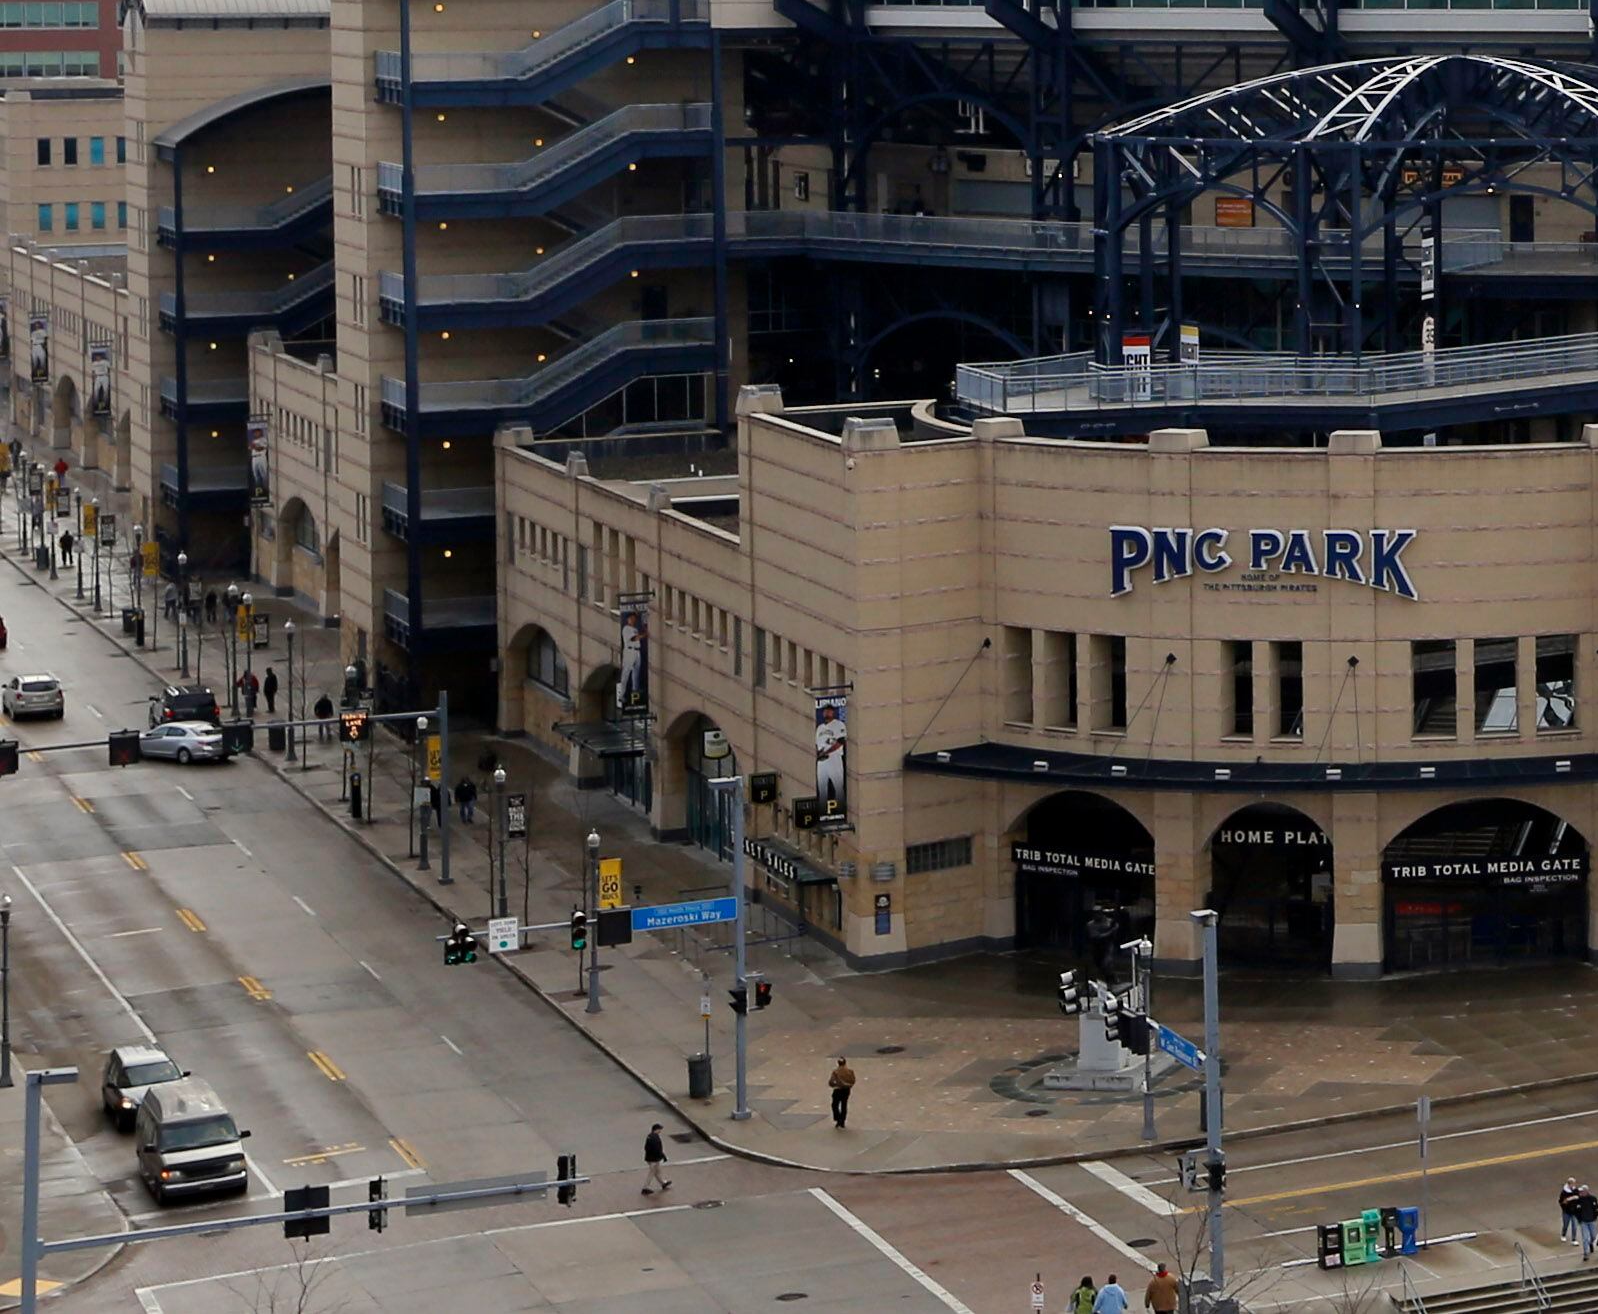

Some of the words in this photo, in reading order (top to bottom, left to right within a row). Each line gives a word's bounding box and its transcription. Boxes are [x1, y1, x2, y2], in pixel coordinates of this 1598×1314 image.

[1110, 526, 1233, 598] PNC
[1249, 529, 1418, 601] PARK
[827, 799, 838, 814] P
[1220, 830, 1274, 844] HOME
[1284, 831, 1330, 845] PLAT
[1016, 848, 1041, 861] TRIB
[1046, 852, 1080, 866] TOTAL
[1085, 856, 1121, 871] MEDIA
[1125, 861, 1155, 875] GATE
[1392, 866, 1427, 878] TRIB
[1434, 863, 1481, 876] TOTAL
[1487, 861, 1535, 874] MEDIA
[1541, 859, 1581, 871] GATE
[1037, 865, 1079, 876] INSPECTION
[1503, 876, 1522, 884] BAG
[1525, 874, 1579, 883] INSPECTION
[602, 882, 619, 893] GO
[647, 913, 698, 926] Mazeroski
[701, 910, 721, 921] Way
